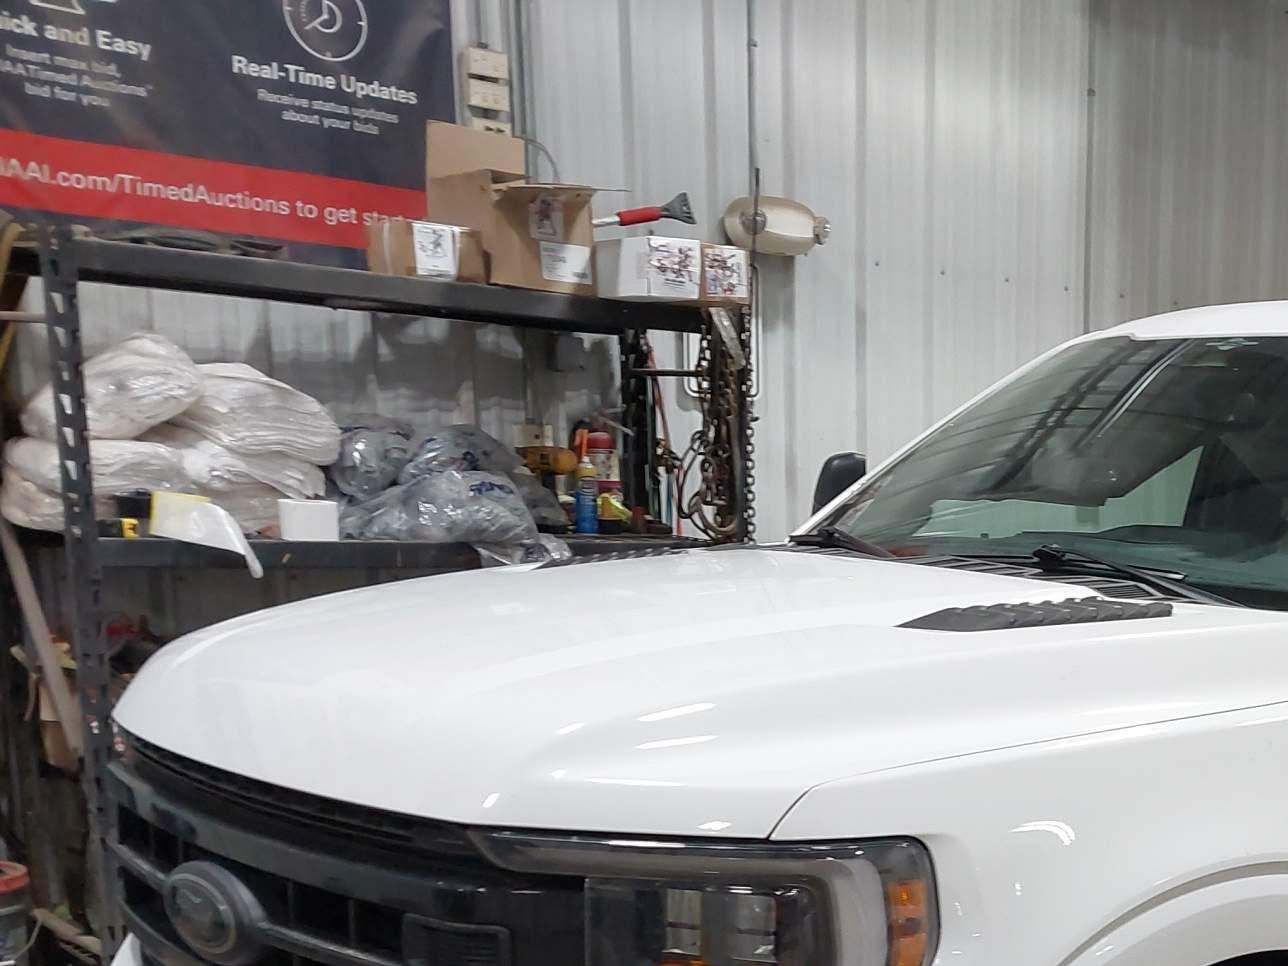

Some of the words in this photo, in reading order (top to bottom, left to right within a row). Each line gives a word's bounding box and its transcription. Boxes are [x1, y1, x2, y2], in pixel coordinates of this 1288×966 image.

[43, 24, 90, 46] and
[95, 29, 152, 61] Easy
[231, 55, 337, 90] Real-Time
[340, 74, 418, 104] Updates
[257, 88, 310, 108] Receive
[311, 99, 350, 115] status
[351, 107, 399, 124] updates
[281, 109, 320, 125] about
[322, 116, 351, 130] your
[353, 120, 380, 135] bids
[296, 199, 318, 218] to
[323, 206, 358, 226] get
